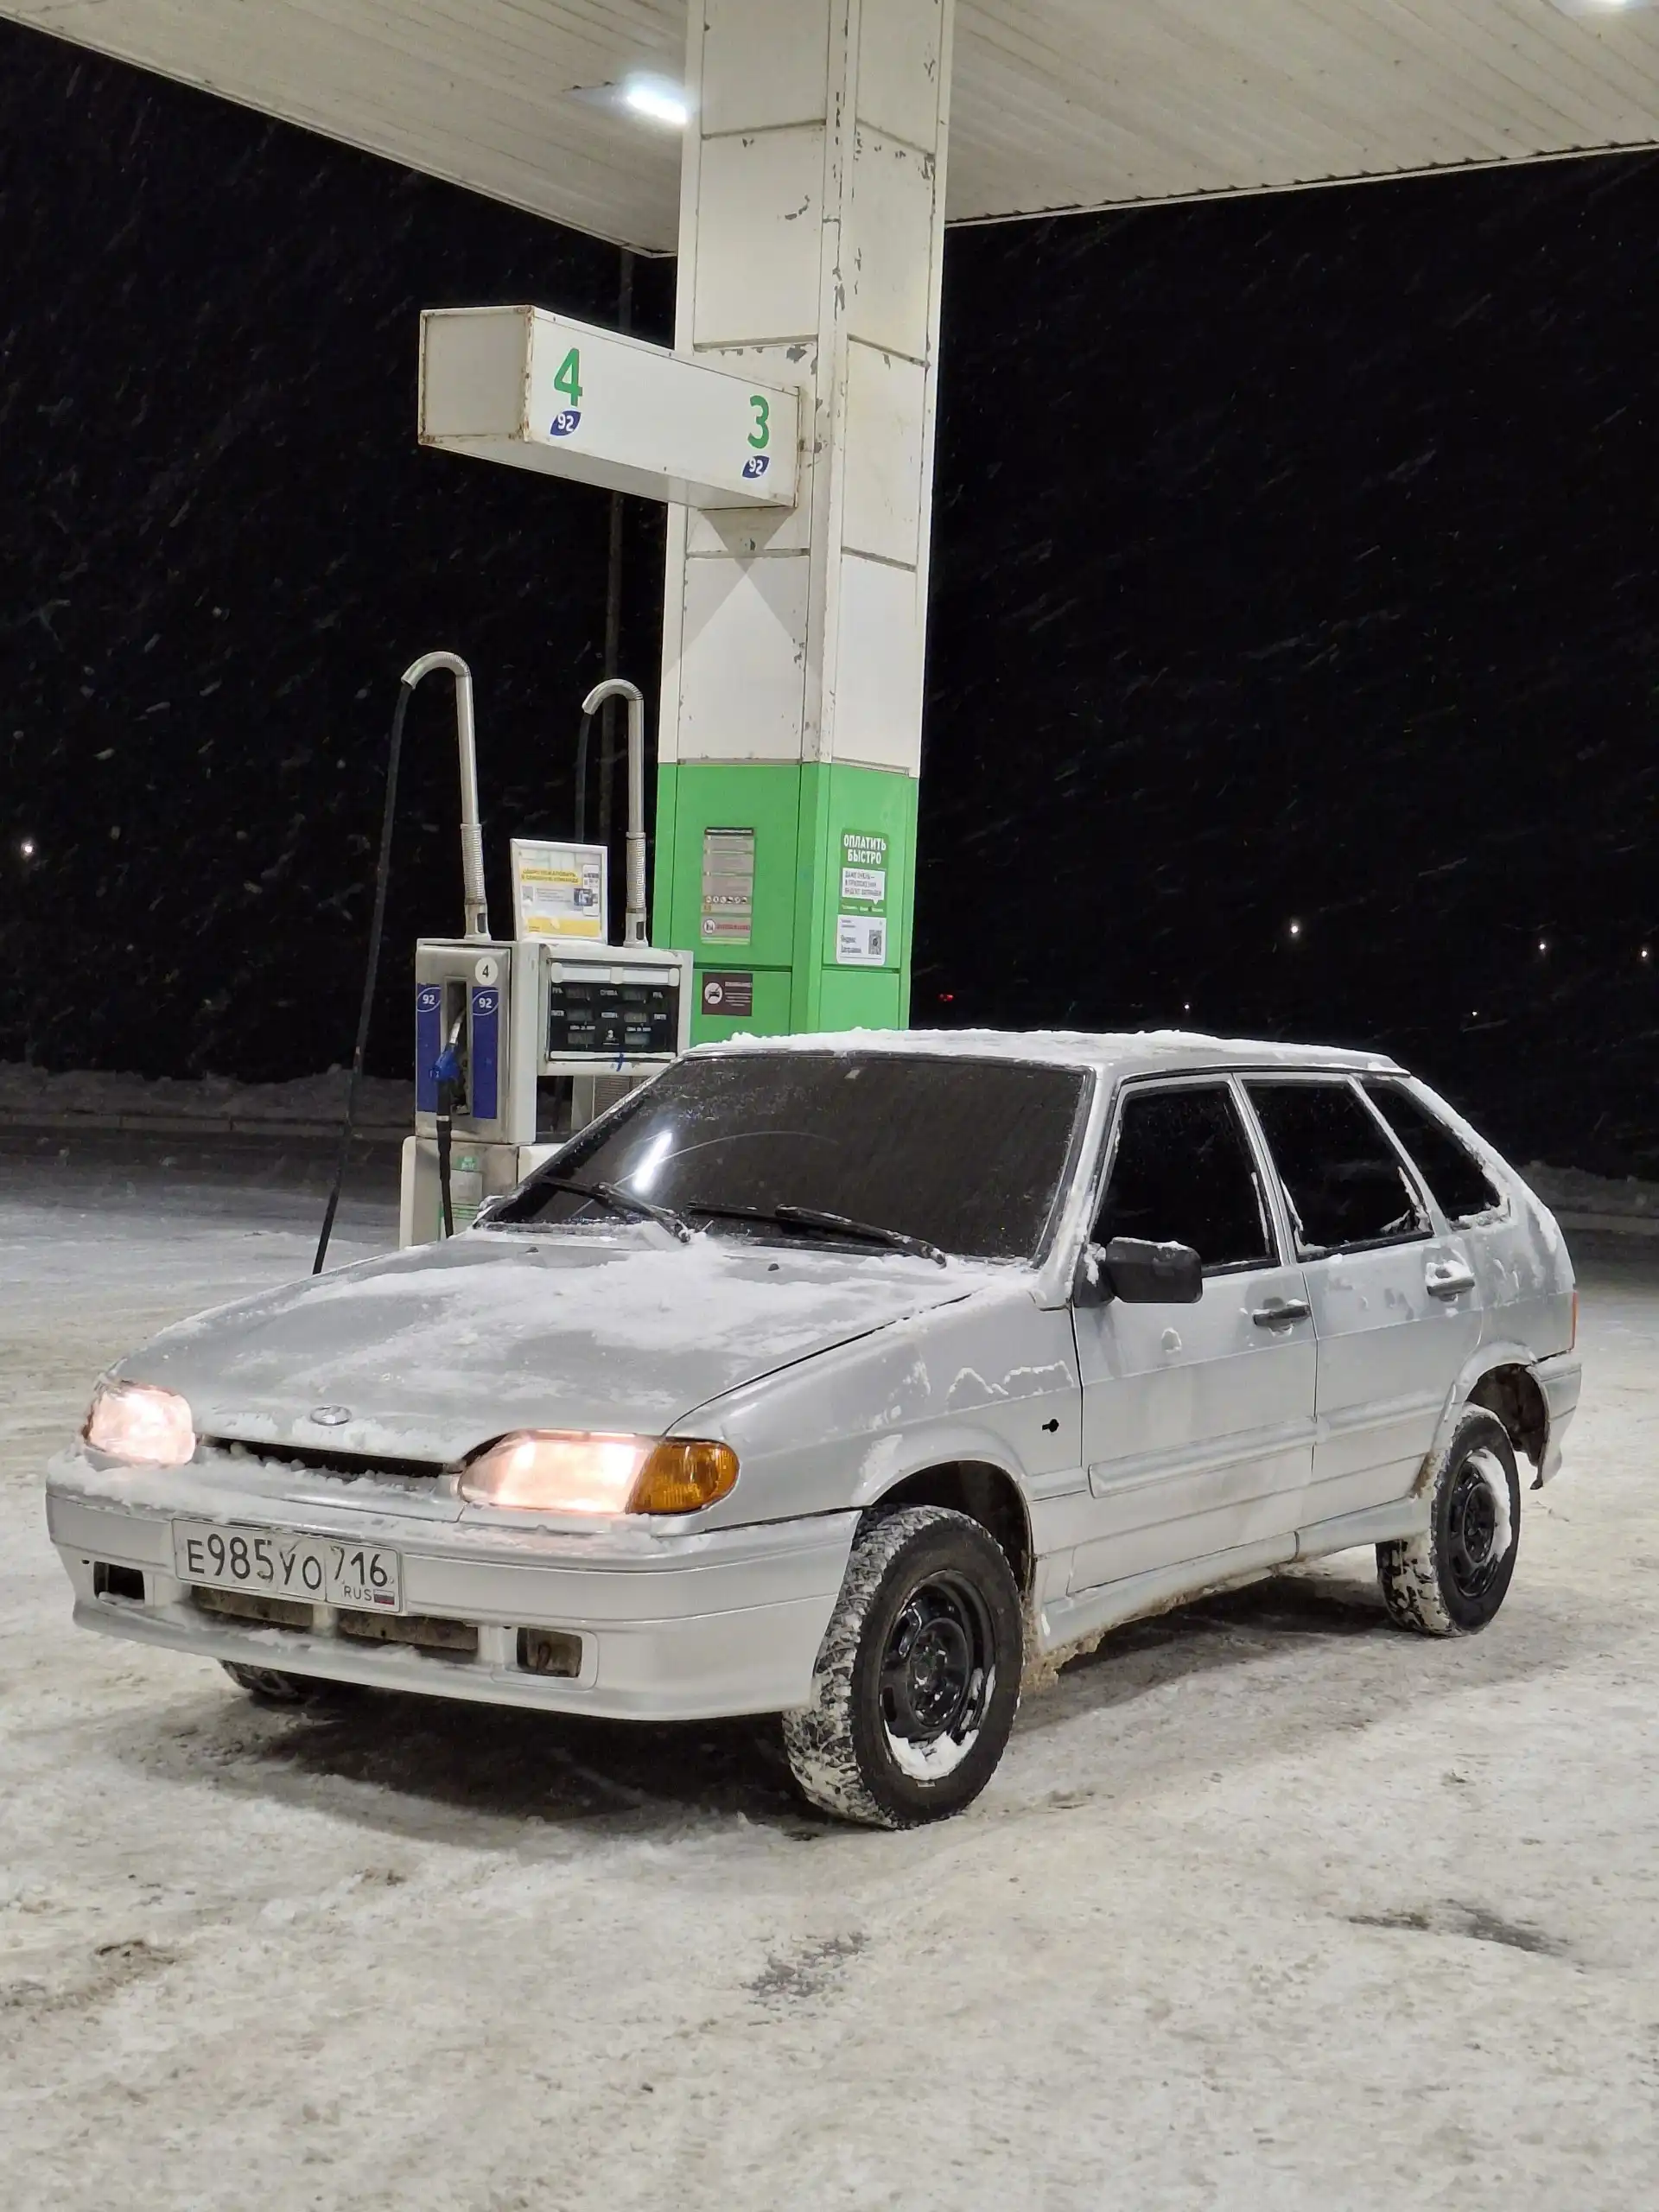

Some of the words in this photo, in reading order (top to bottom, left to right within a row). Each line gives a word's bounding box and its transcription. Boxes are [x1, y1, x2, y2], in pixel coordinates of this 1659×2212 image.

[554, 347, 583, 406] 4
[556, 414, 575, 432] 92
[747, 395, 770, 449] 3
[748, 458, 764, 475] 92
[843, 834, 887, 851] ОПЛАТИТЬ
[848, 850, 881, 865] БЫСТРО
[481, 964, 490, 978] 4
[423, 994, 435, 1005] 92
[479, 997, 493, 1008] 92
[344, 1585, 372, 1601] RUS
